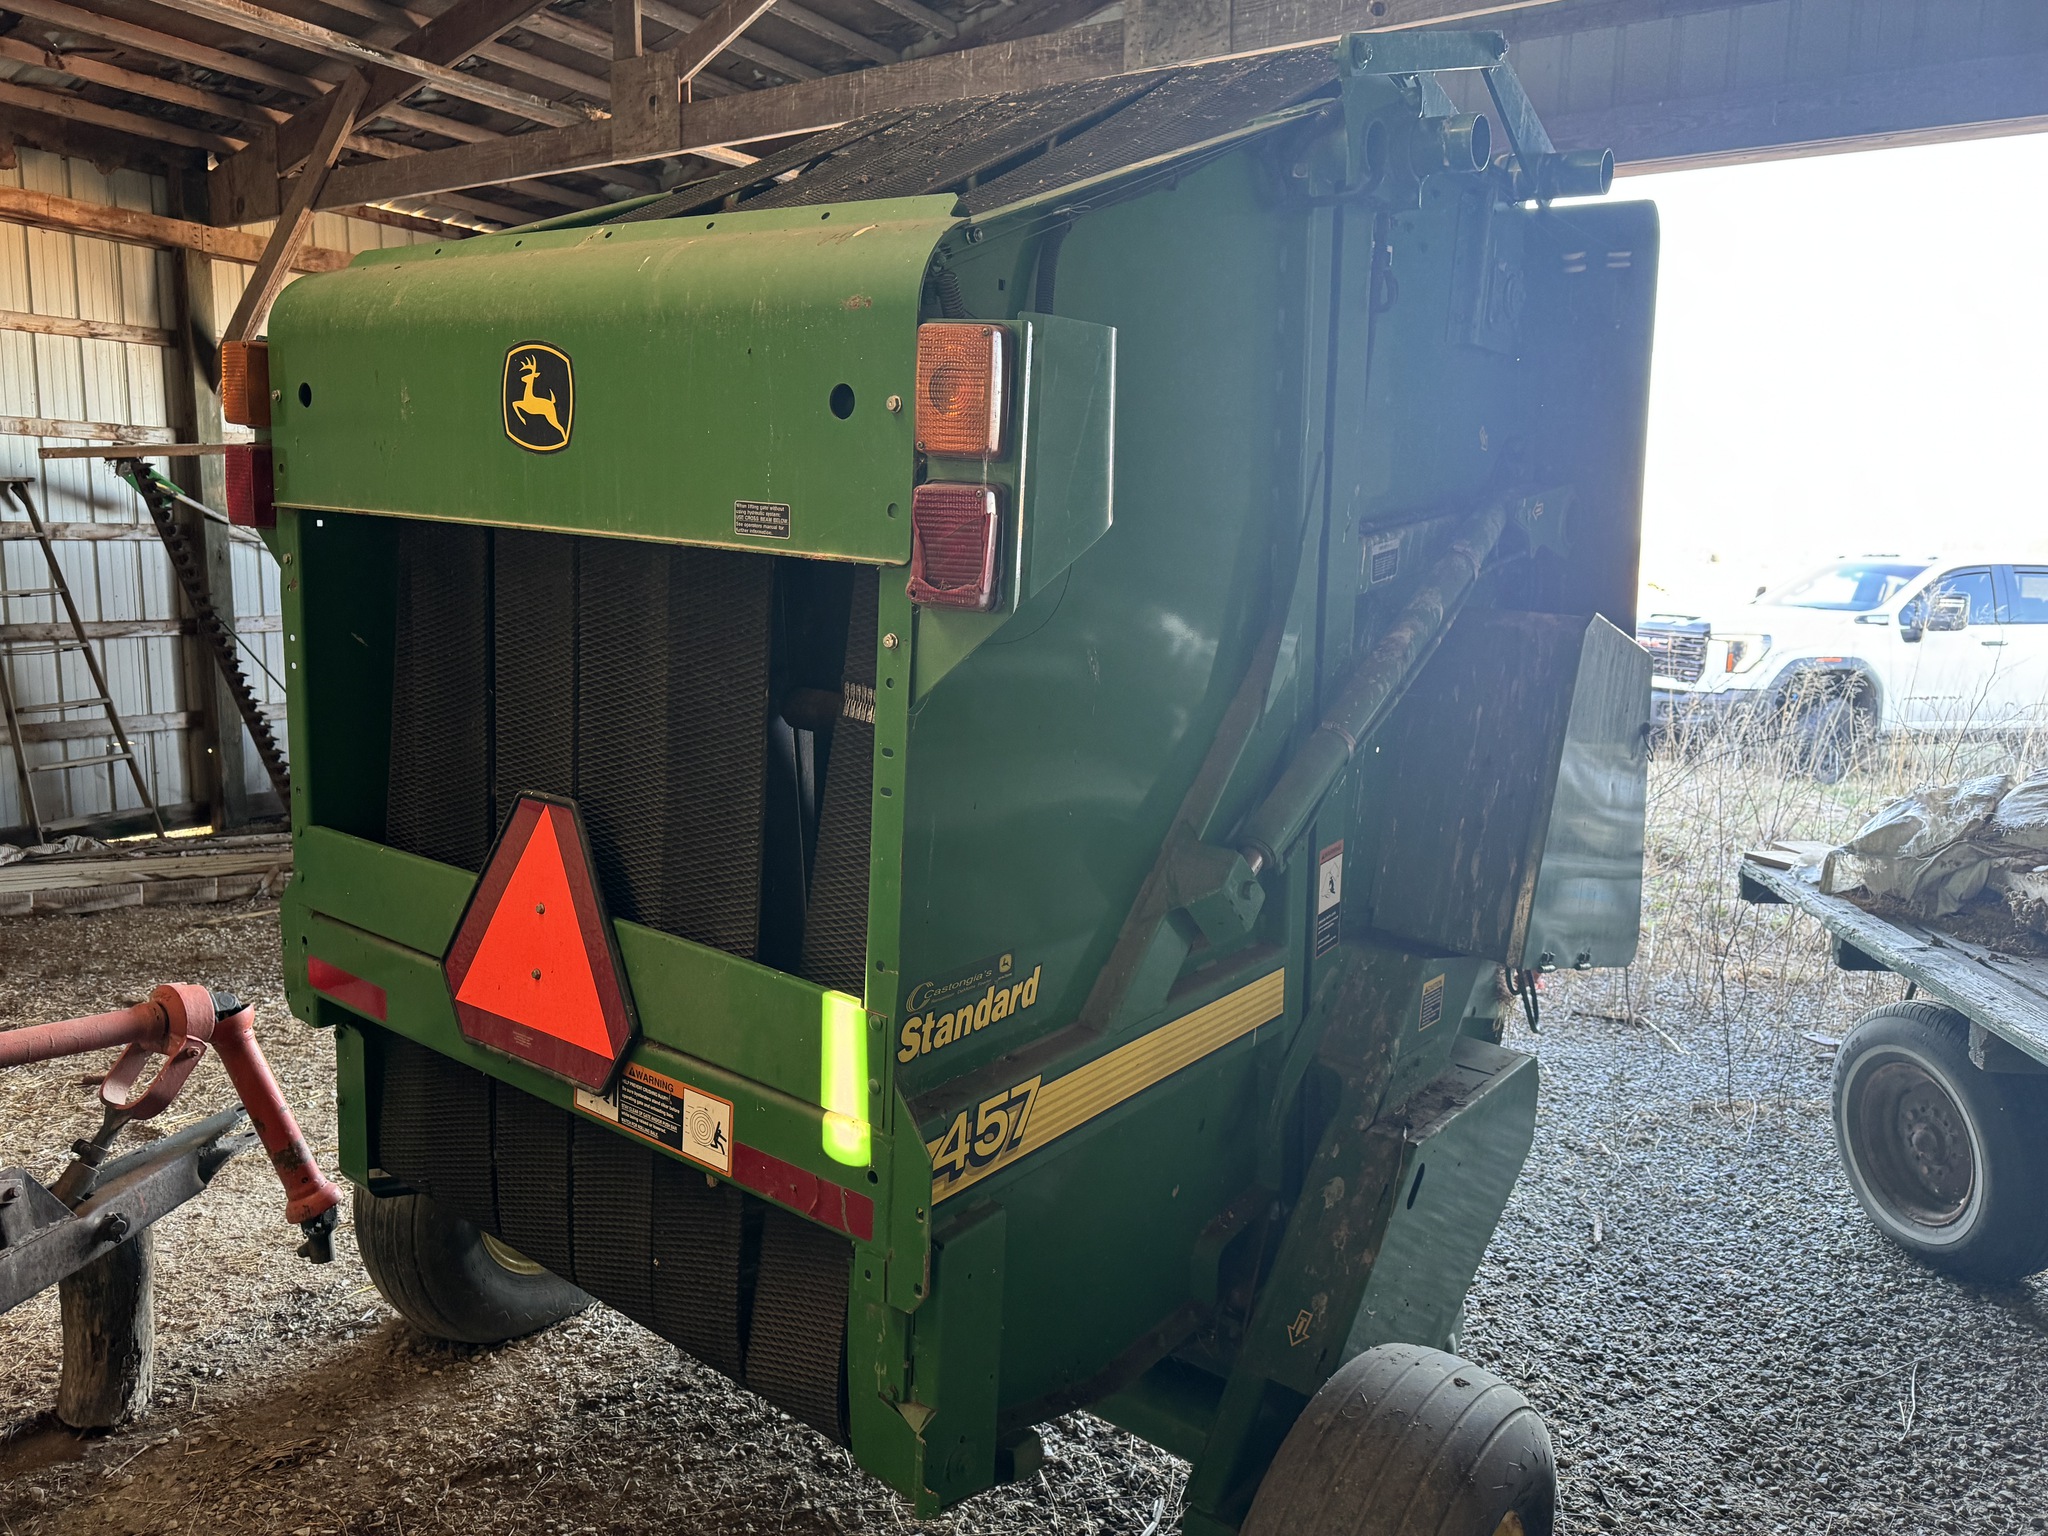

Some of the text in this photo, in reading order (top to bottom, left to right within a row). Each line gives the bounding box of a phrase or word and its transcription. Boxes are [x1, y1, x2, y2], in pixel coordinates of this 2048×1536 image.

[897, 964, 1042, 1064] Standard
[636, 1070, 674, 1093] WARNING
[933, 1075, 1042, 1175] 457
